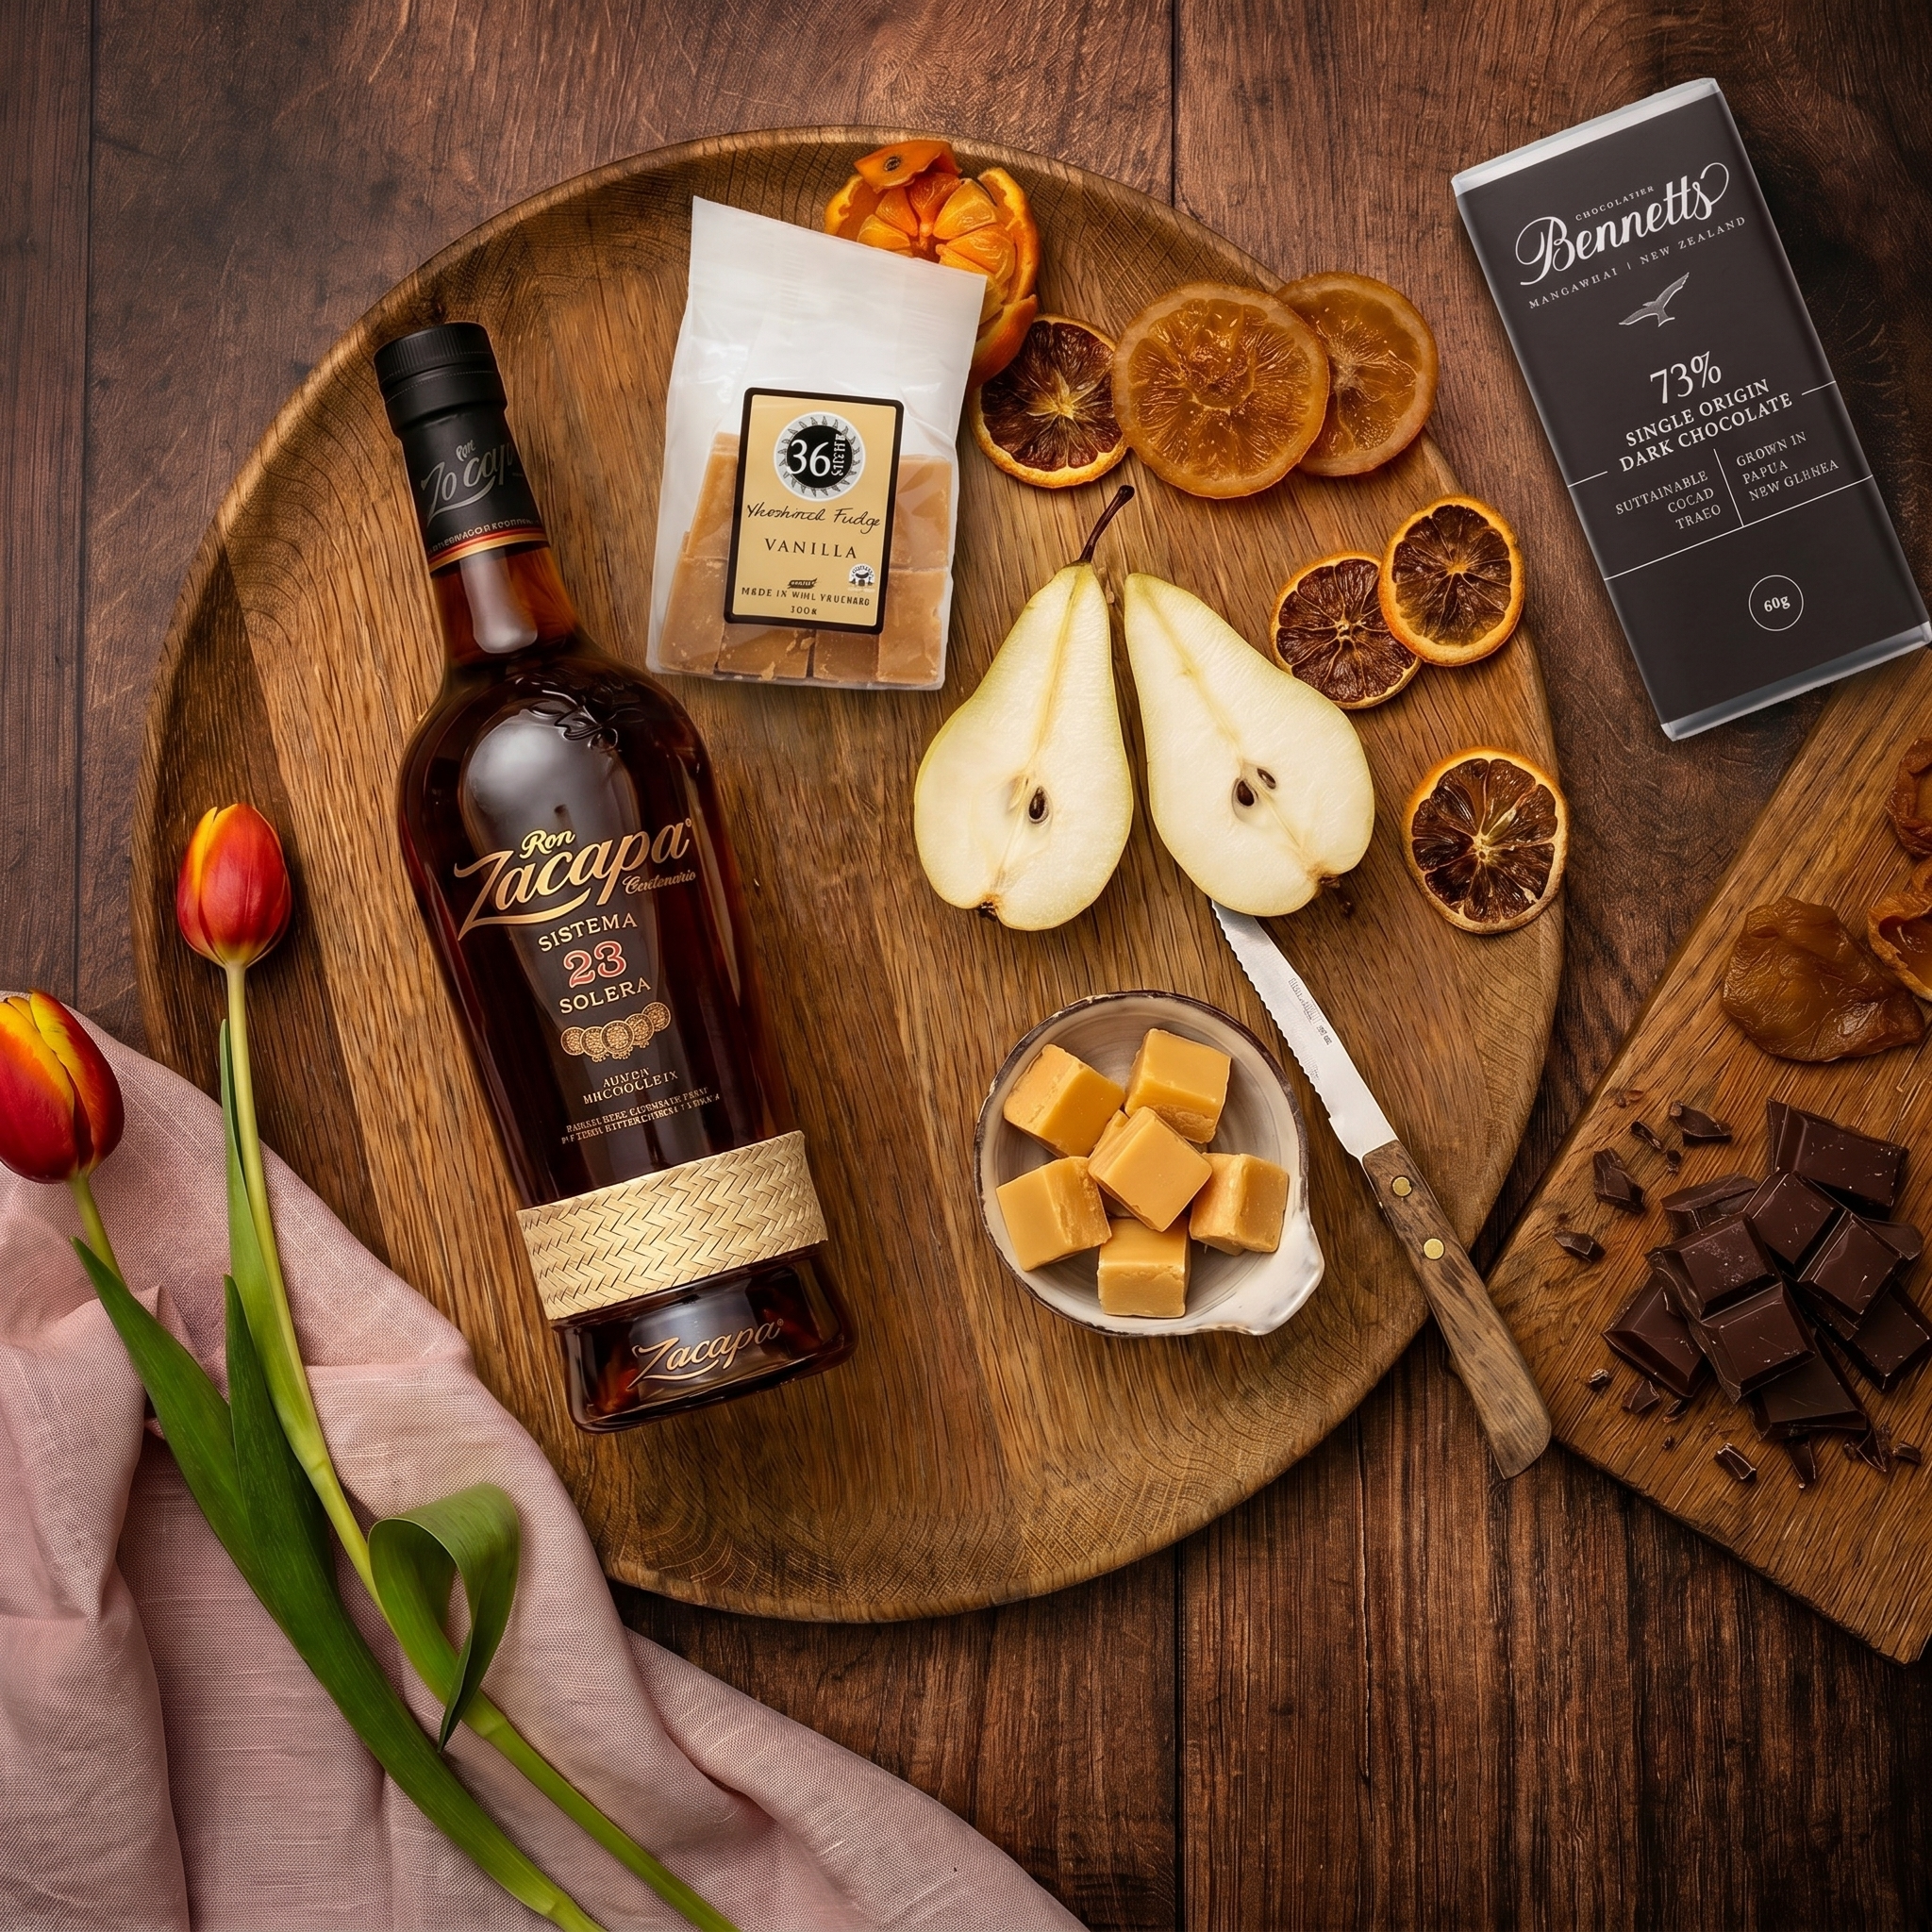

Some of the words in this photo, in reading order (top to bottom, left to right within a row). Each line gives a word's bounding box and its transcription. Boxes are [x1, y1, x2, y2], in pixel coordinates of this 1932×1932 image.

[1575, 186, 1655, 221] CHOCOLATIER
[1640, 246, 1671, 265] NEW
[1677, 216, 1746, 250] ZEALAND
[1650, 351, 1722, 404] 73%
[1625, 408, 1695, 447] SINGLE
[1699, 378, 1770, 417] ORIGIN
[1619, 440, 1674, 472] DARK
[1678, 392, 1792, 448] CHOCOLATE
[1736, 439, 1789, 467] GROWN
[1790, 431, 1807, 445] IN
[786, 439, 831, 477] 36
[1742, 459, 1789, 485] PAPUA
[1748, 480, 1781, 502] NEW
[833, 508, 881, 535] Fudge
[764, 538, 858, 559] VANILLA
[1763, 595, 1790, 612] 60g
[519, 829, 575, 859] Ron
[454, 818, 692, 941] Zacapa
[538, 912, 638, 952] SISTEMA
[563, 940, 627, 989] 23
[559, 977, 651, 1014] SOLERA
[626, 1318, 784, 1391] Zacapa
